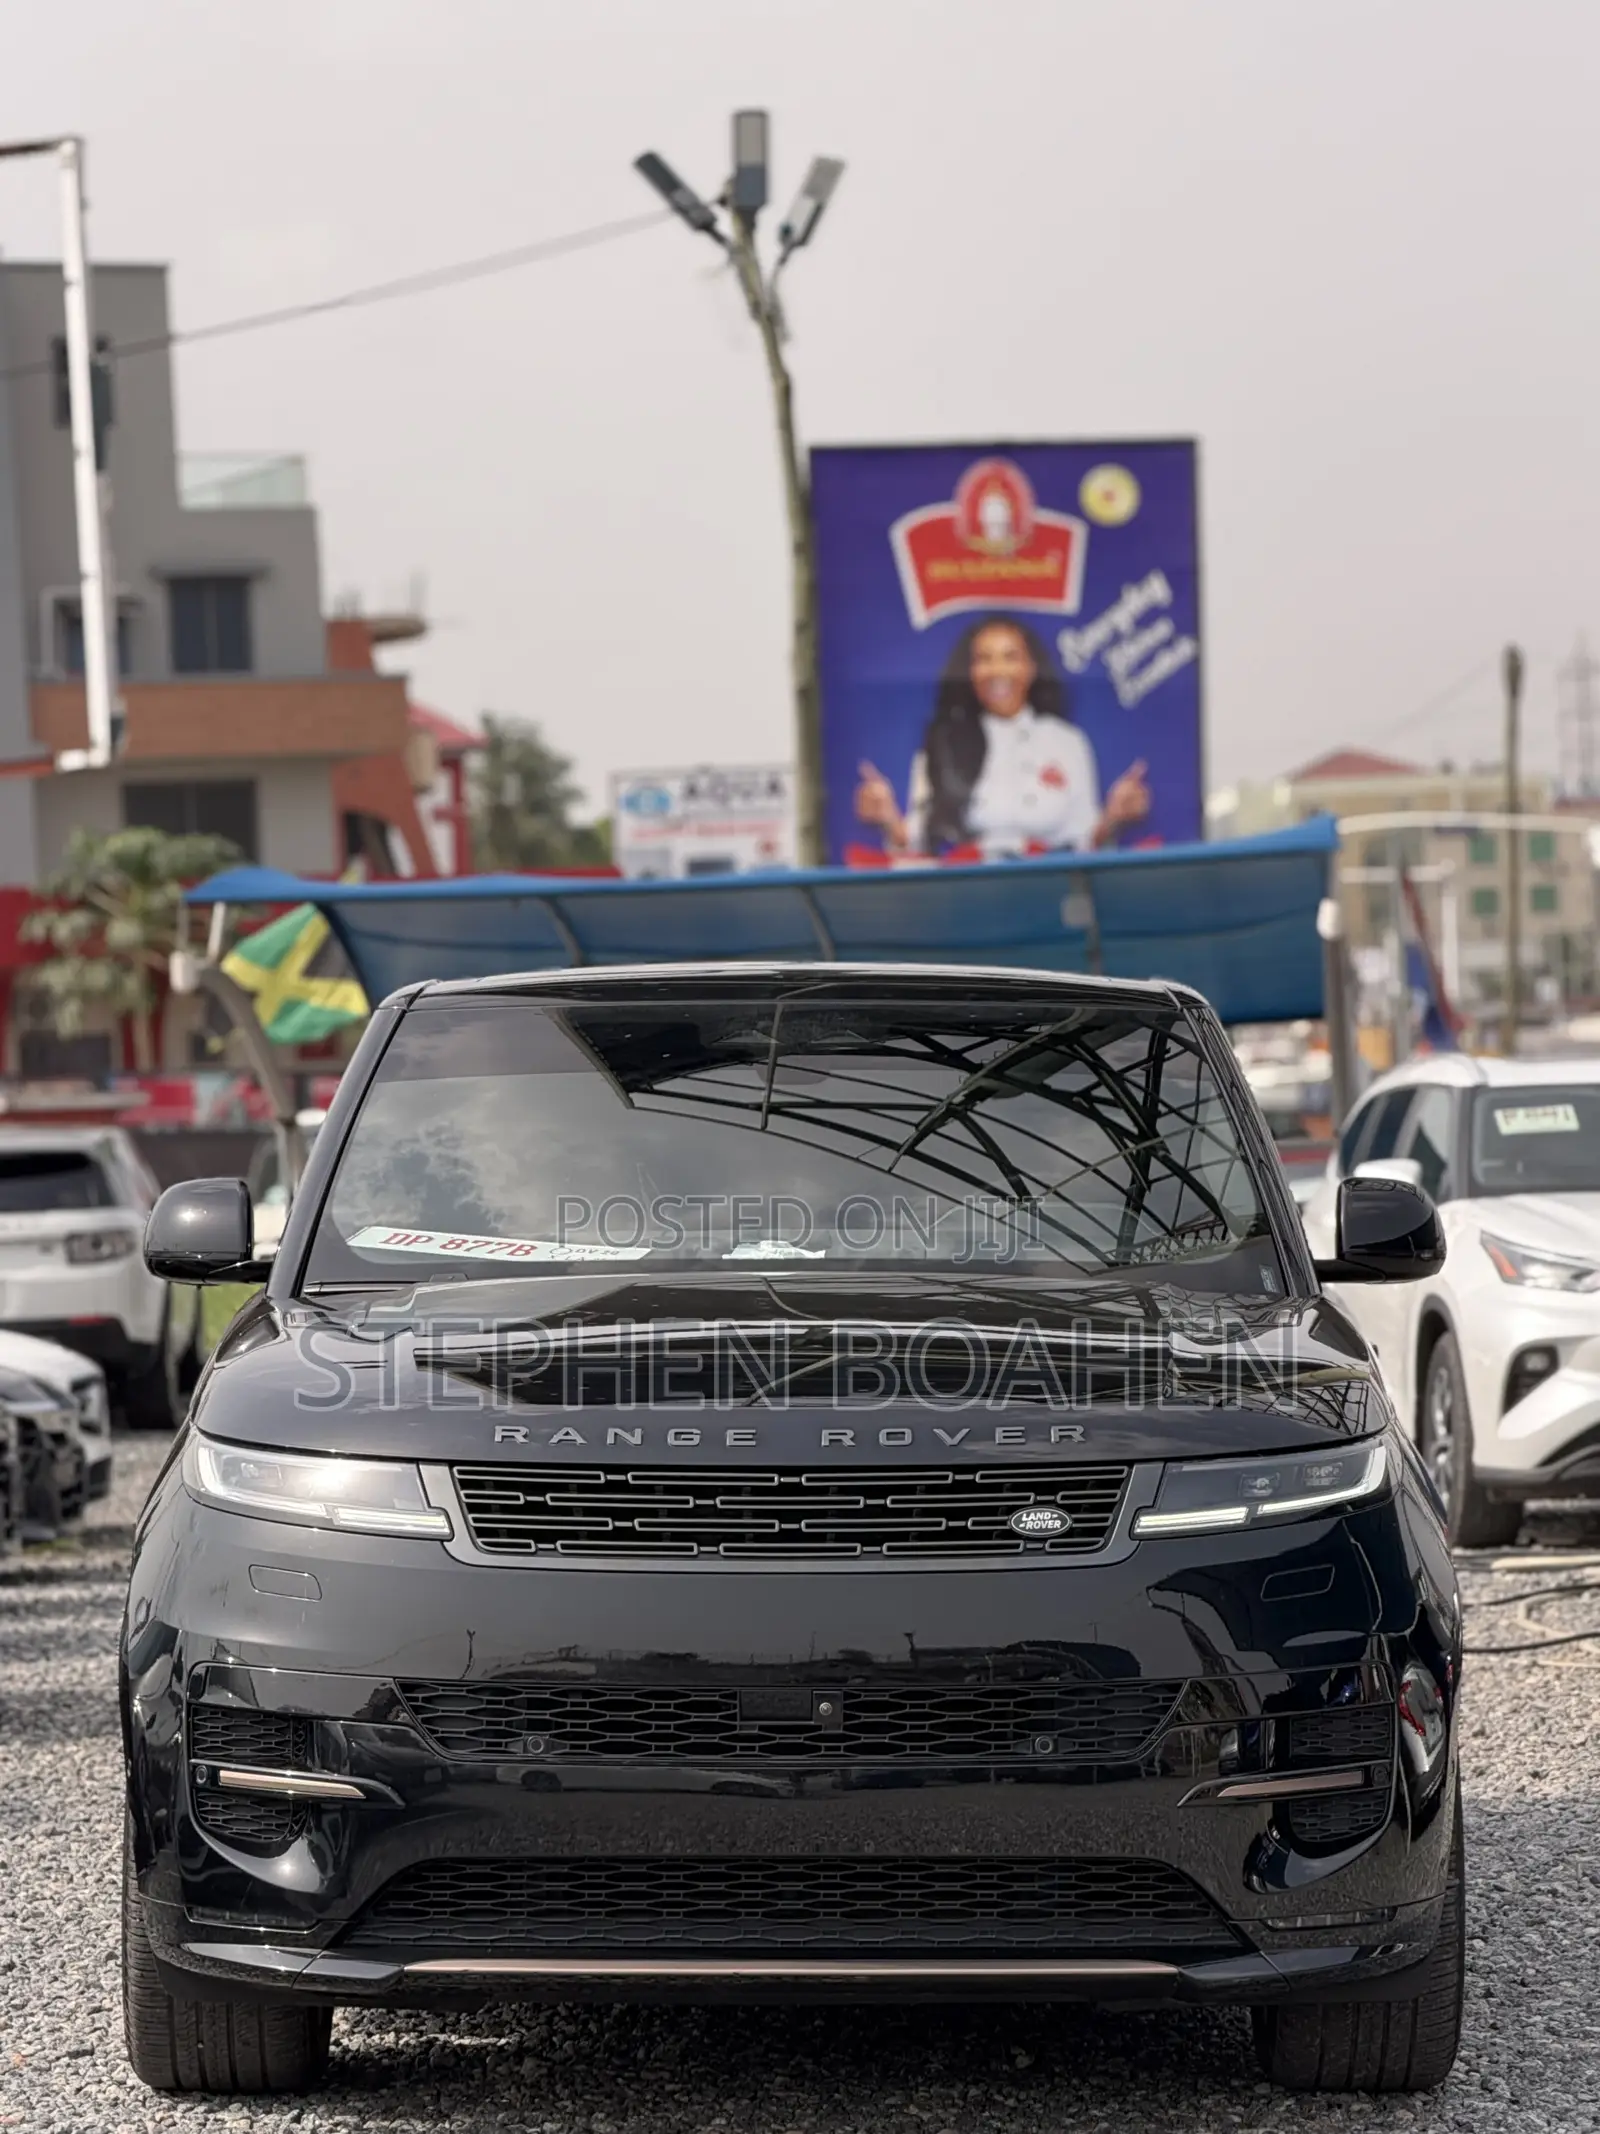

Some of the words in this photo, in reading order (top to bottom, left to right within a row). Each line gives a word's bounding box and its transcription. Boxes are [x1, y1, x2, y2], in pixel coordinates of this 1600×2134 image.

[378, 1232, 435, 1247] DP
[494, 1425, 758, 1448] RANGE
[821, 1424, 1086, 1448] ROVER
[1022, 1511, 1052, 1522] LAND
[1025, 1519, 1062, 1530] ROVER
